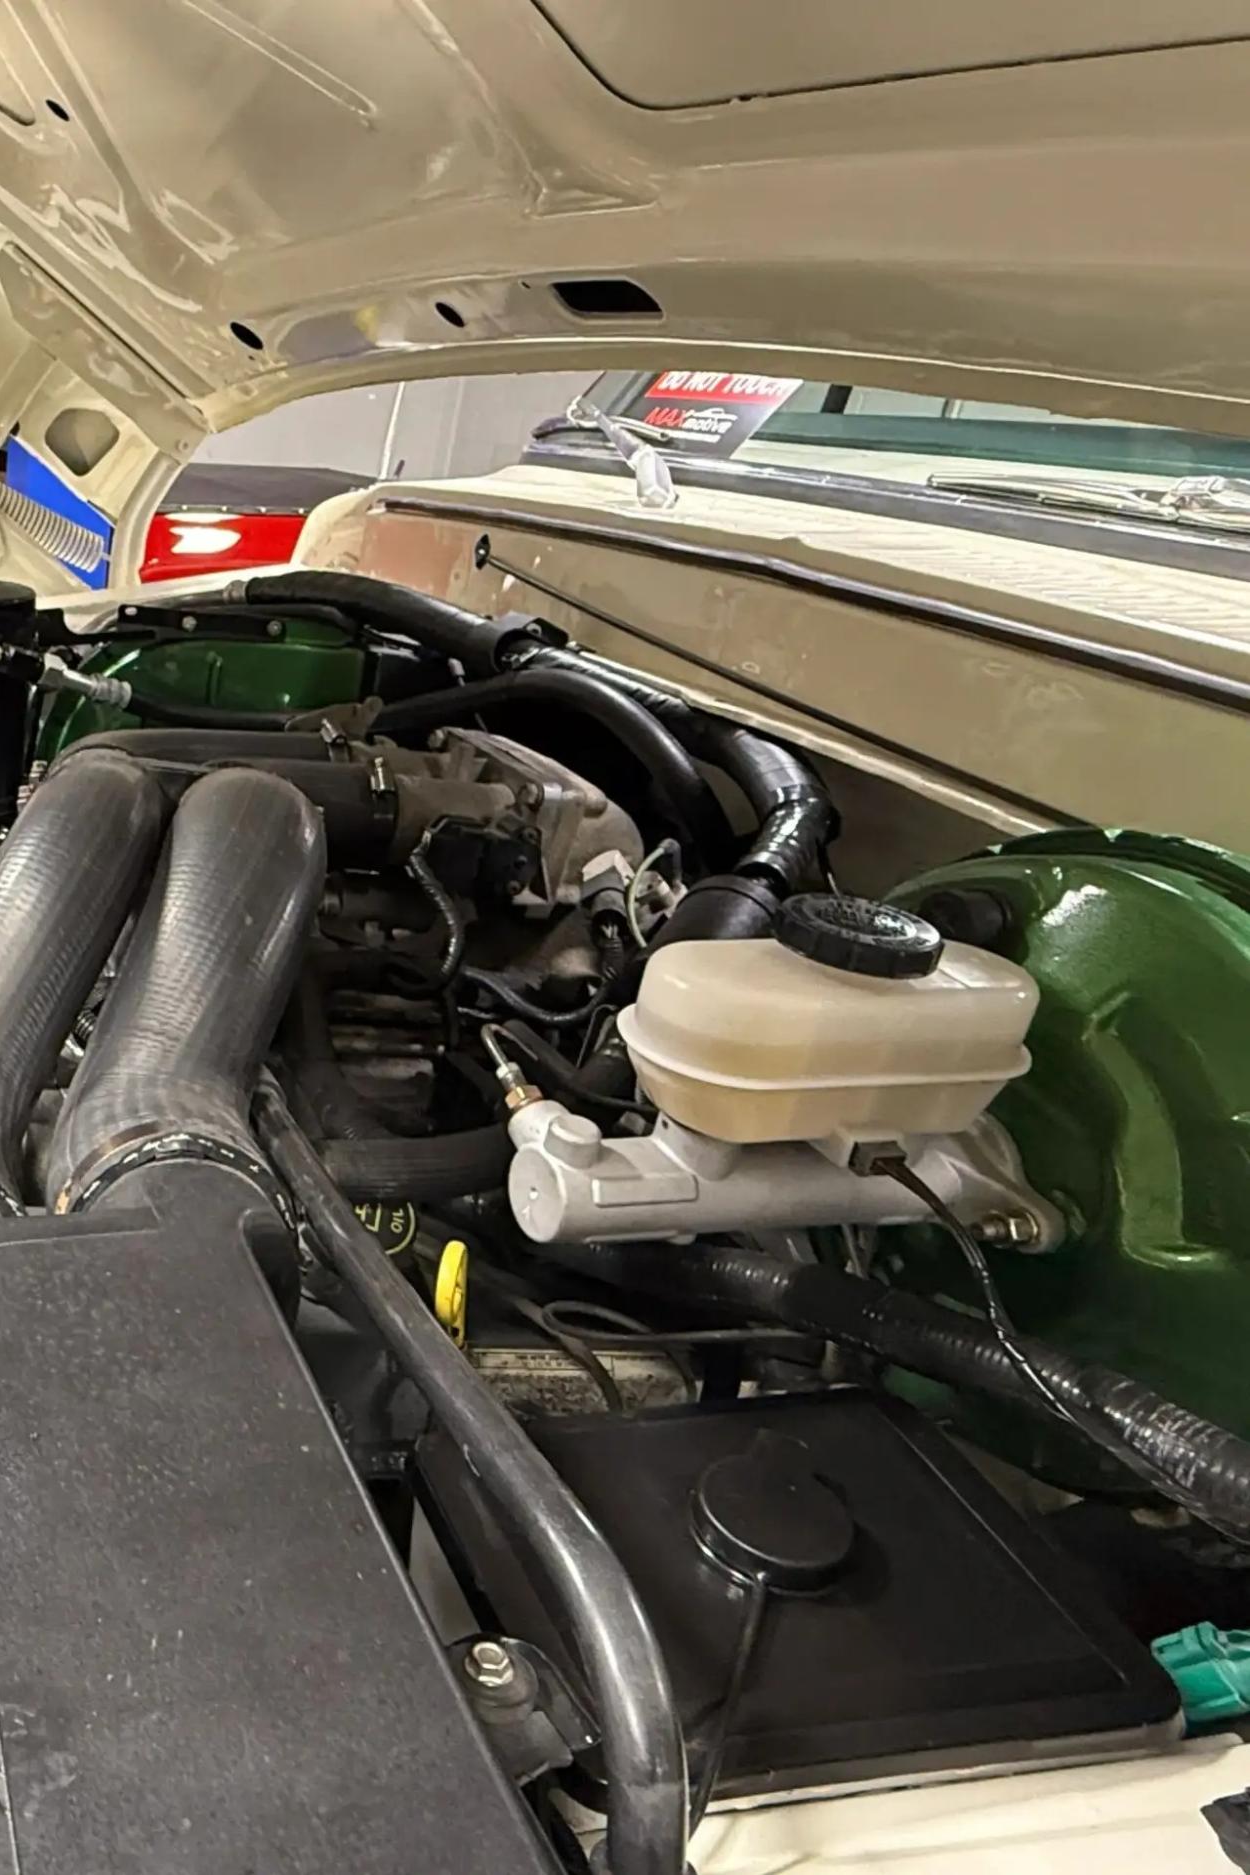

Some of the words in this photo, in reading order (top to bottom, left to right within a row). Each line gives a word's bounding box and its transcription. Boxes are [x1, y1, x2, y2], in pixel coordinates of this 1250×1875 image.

[658, 371, 691, 390] DO
[683, 371, 732, 392] NOT
[390, 1208, 405, 1234] OIL
